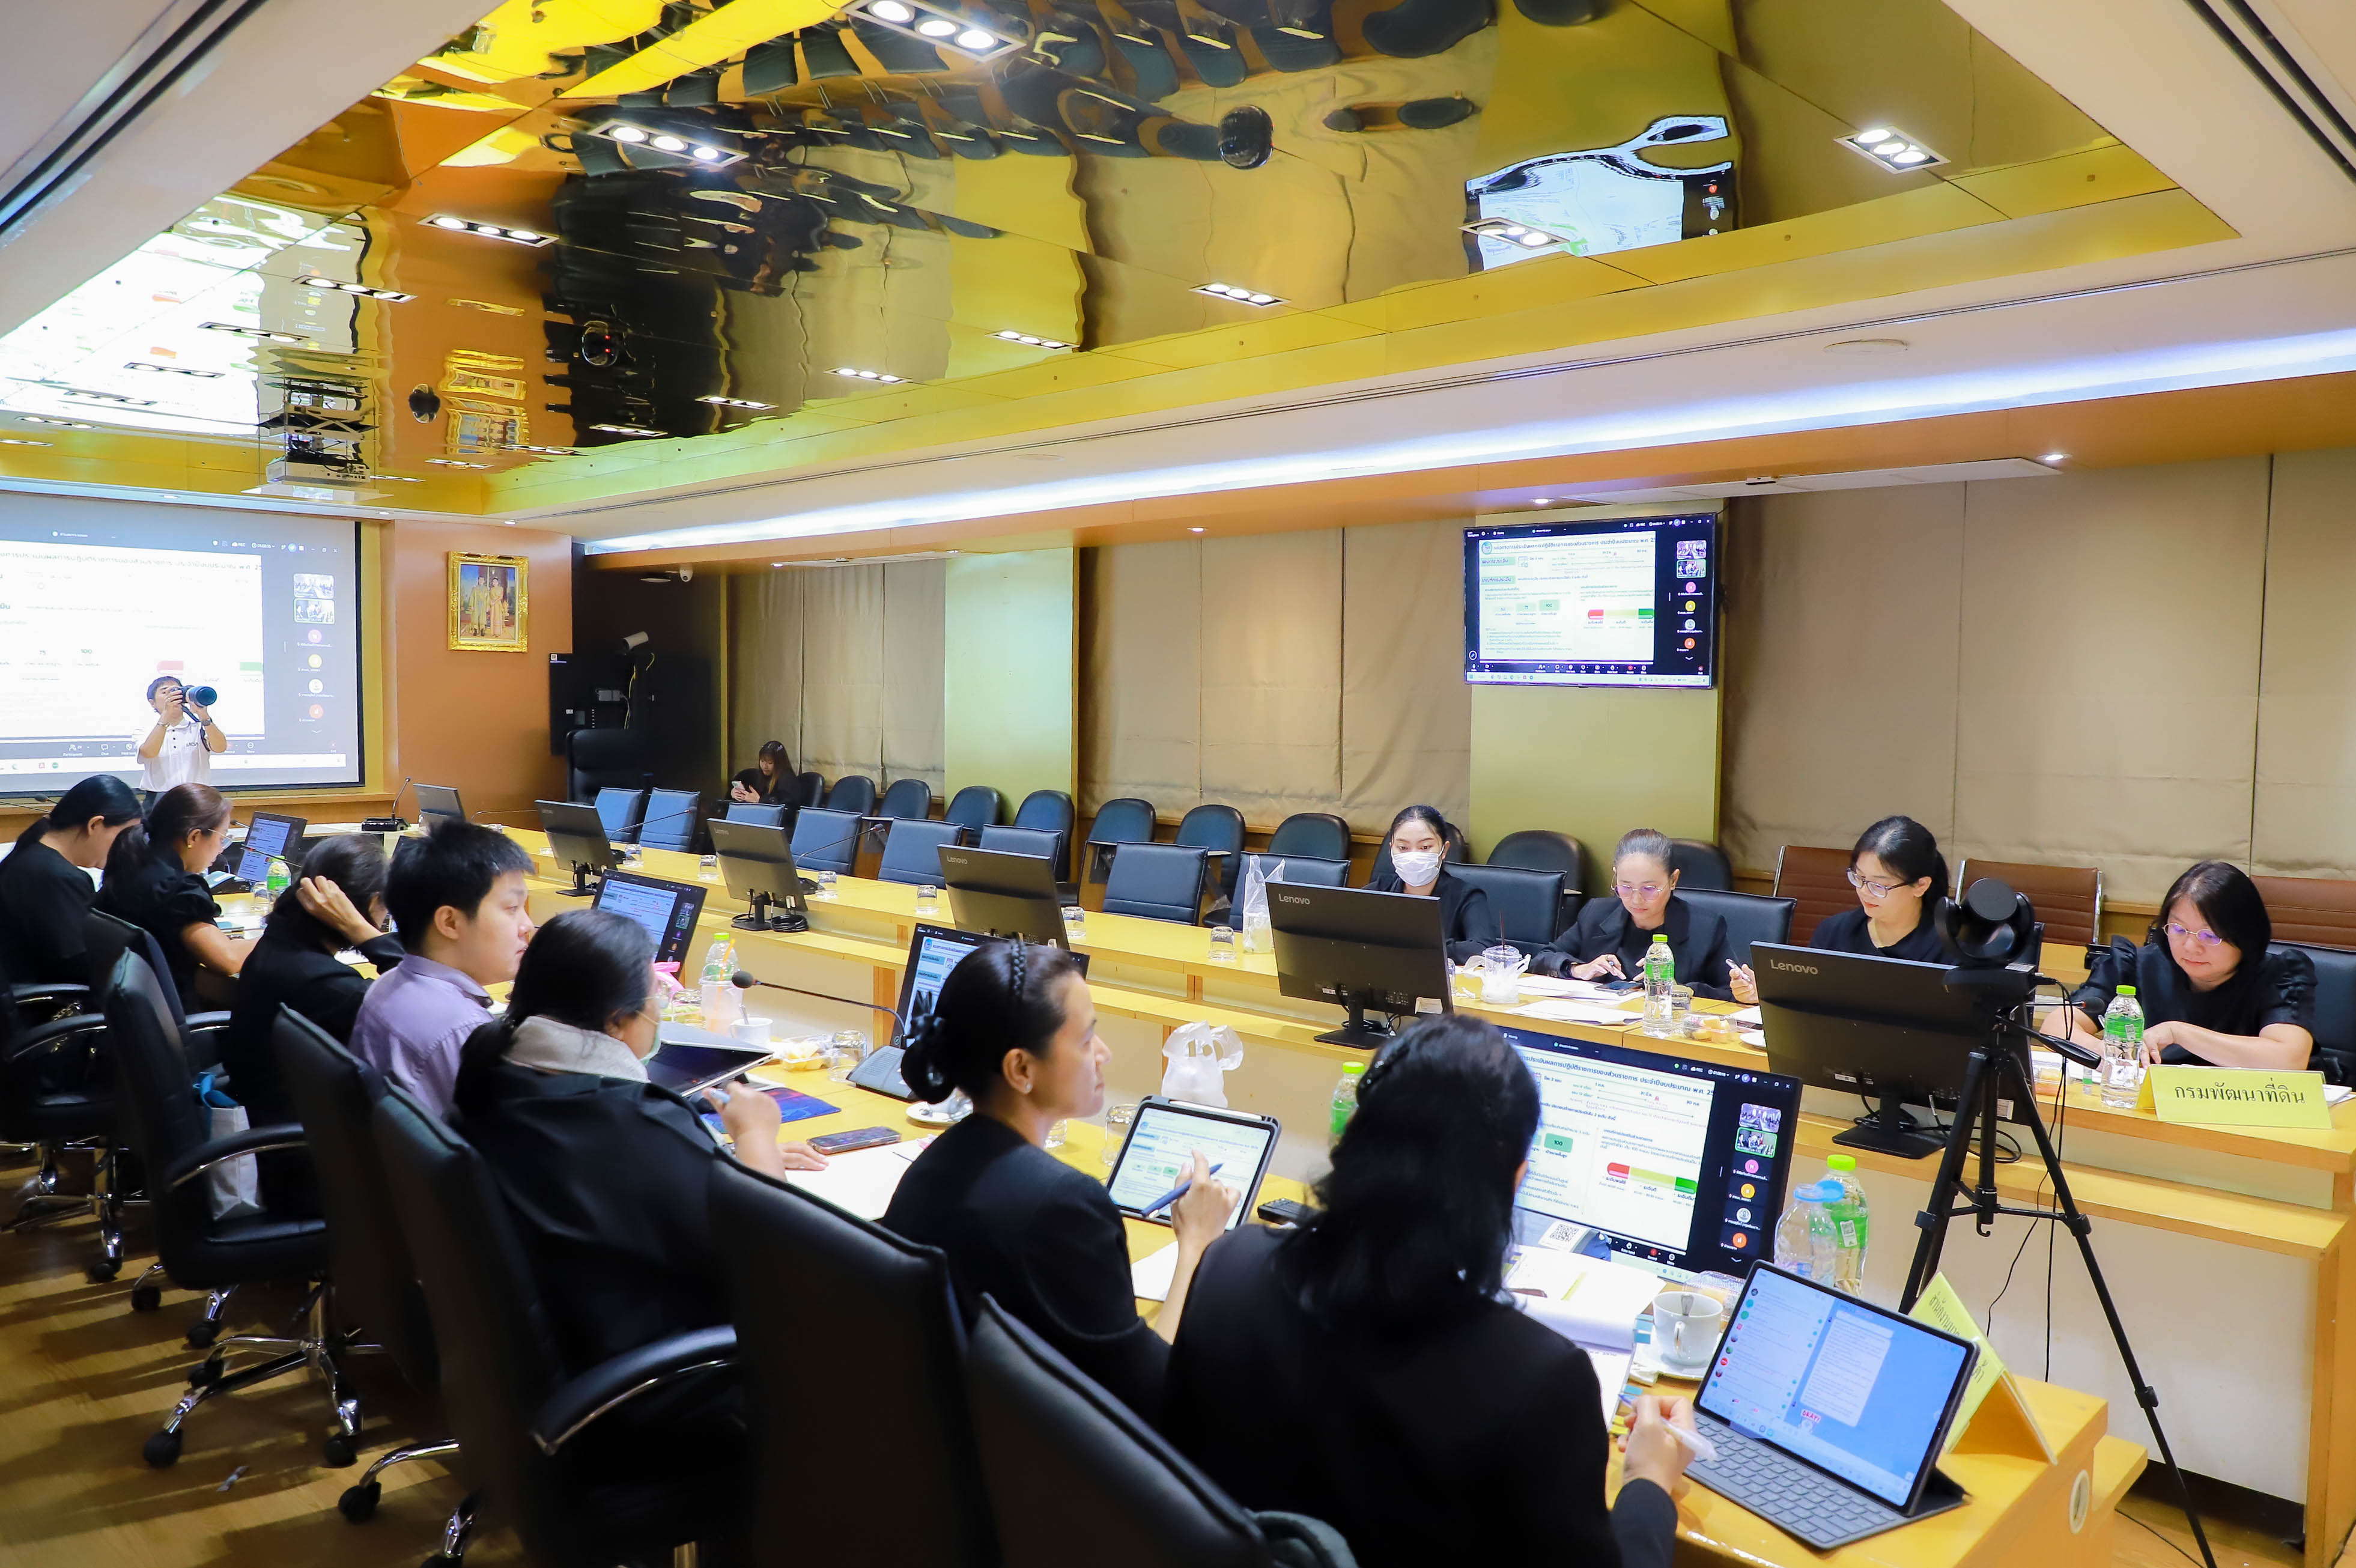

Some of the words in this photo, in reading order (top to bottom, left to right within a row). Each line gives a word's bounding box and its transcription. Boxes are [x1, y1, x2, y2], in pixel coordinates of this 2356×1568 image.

[947, 855, 968, 865] Lenovo
[1278, 893, 1310, 905] Lenovo
[1770, 959, 1818, 974] Lenovo
[1521, 1056, 1638, 1082] ารประเมินผลการปฏิบัติราชการของส่วนราชการ
[2175, 1077, 2306, 1104] กรมพัฒนาที่ดิน
